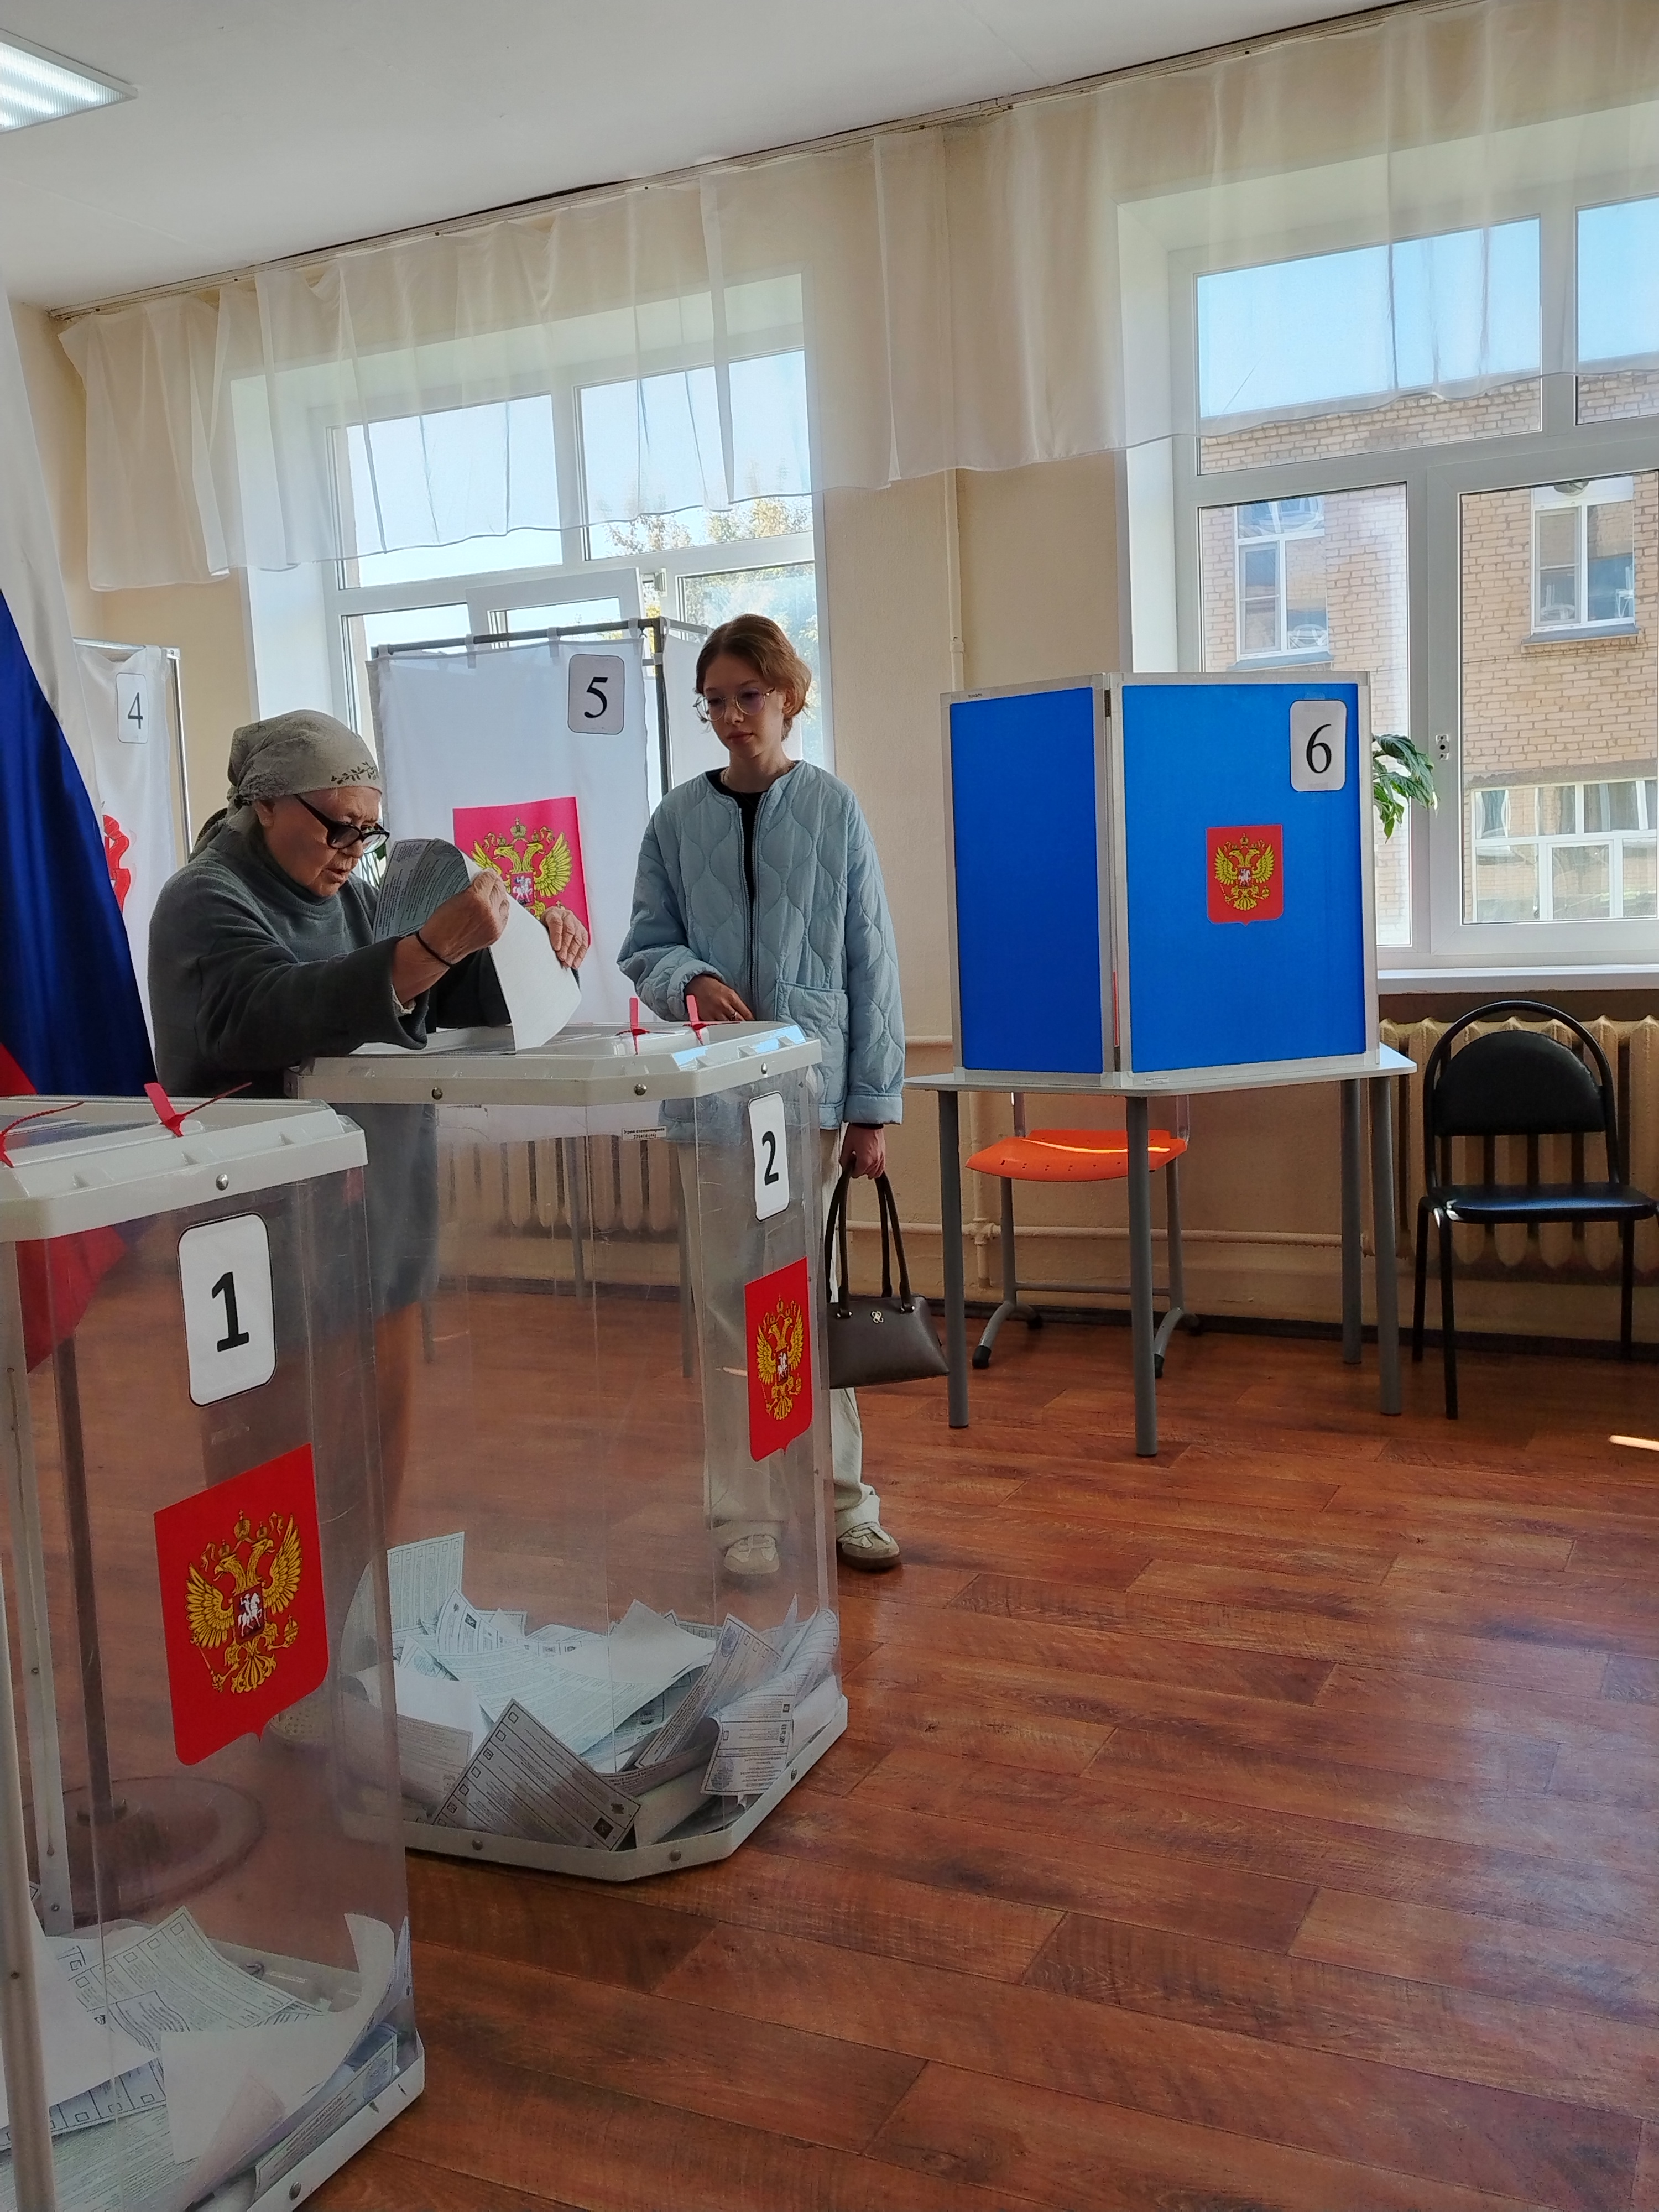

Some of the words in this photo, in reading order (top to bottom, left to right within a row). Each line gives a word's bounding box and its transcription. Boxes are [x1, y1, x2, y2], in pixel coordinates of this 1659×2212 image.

[128, 692, 143, 729] 4
[584, 676, 608, 718] 5
[1306, 723, 1332, 774] 6
[761, 1131, 779, 1186] 2
[211, 1271, 249, 1353] 1
